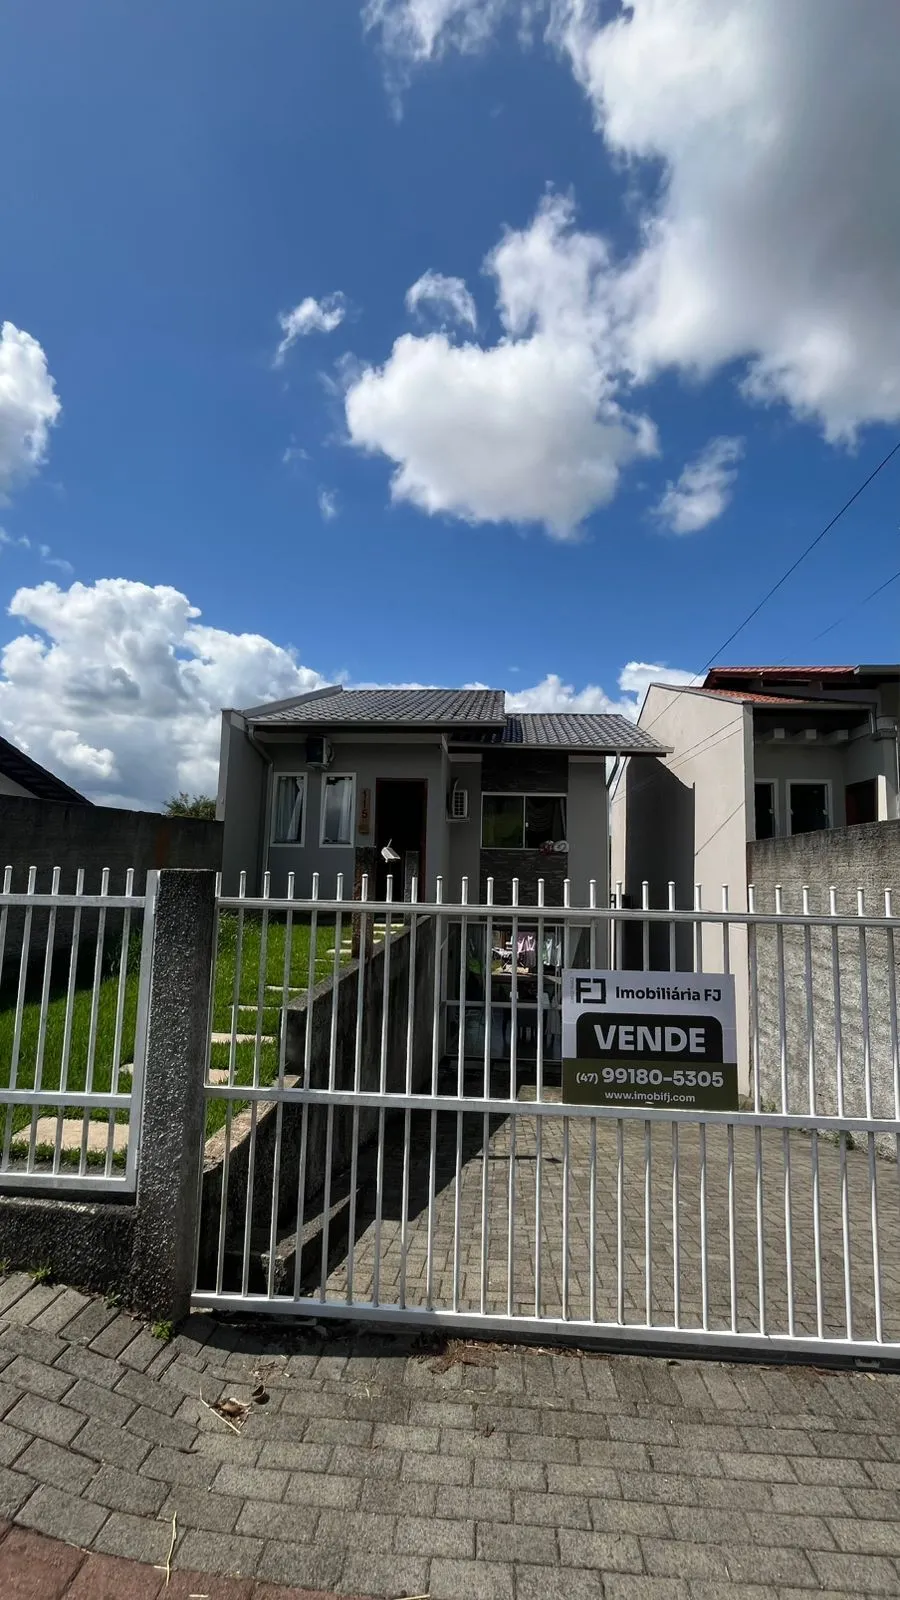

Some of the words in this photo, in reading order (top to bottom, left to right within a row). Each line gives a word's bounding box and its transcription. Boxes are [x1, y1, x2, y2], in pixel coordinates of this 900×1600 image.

[616, 986, 700, 1001] Imobiliária
[704, 989, 721, 1002] FJ
[593, 1025, 706, 1053] VENDE
[576, 1072, 598, 1084] (47)
[602, 1067, 724, 1087] 99180-5305
[605, 1091, 696, 1103] www.imobifj.com
